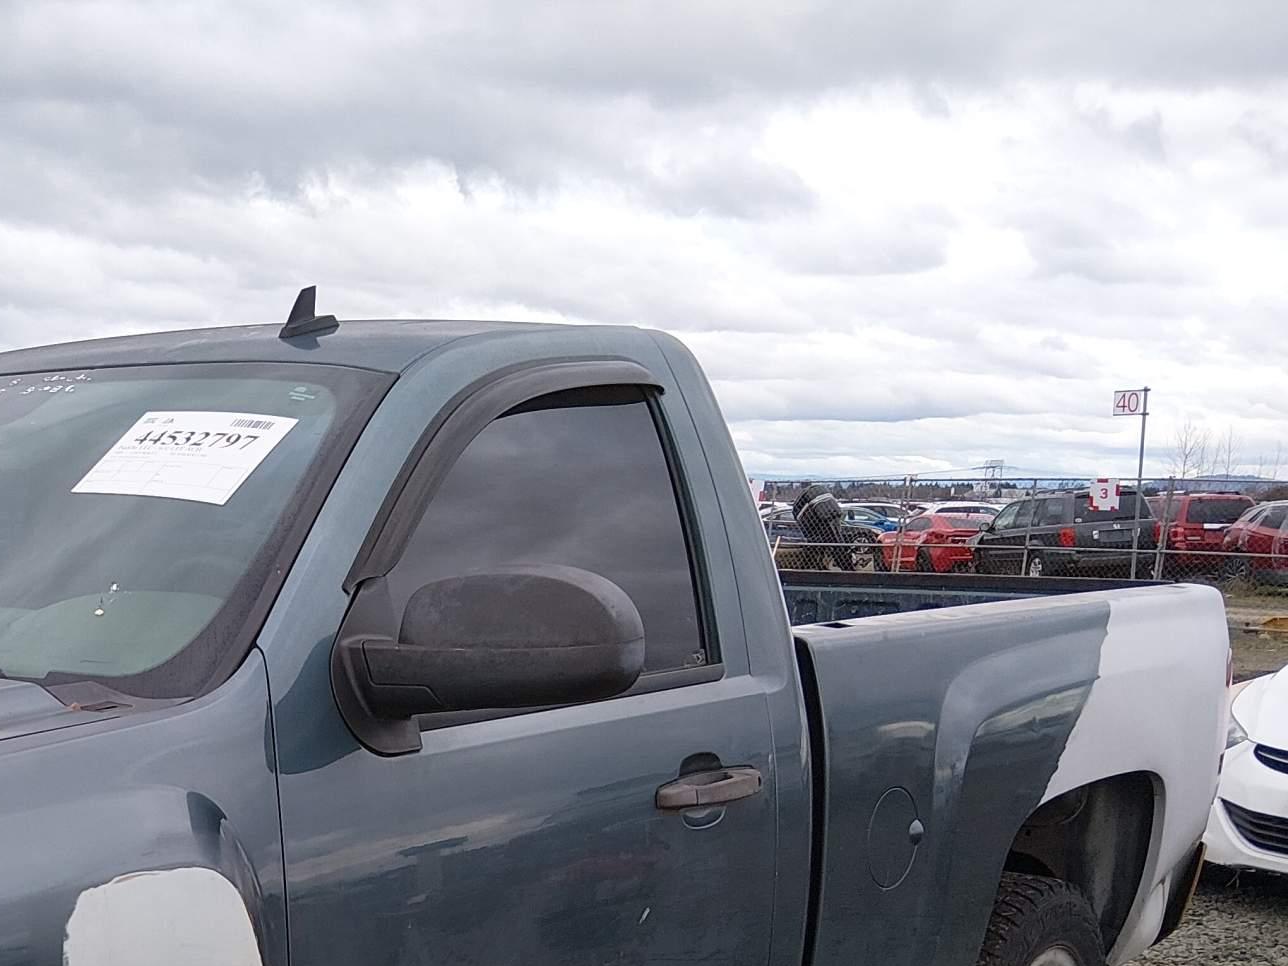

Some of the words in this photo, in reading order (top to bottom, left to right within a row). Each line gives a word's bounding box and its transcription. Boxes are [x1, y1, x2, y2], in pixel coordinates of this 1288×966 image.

[1115, 392, 1139, 413] 40
[134, 430, 261, 452] 44532797
[1099, 487, 1109, 500] 3
